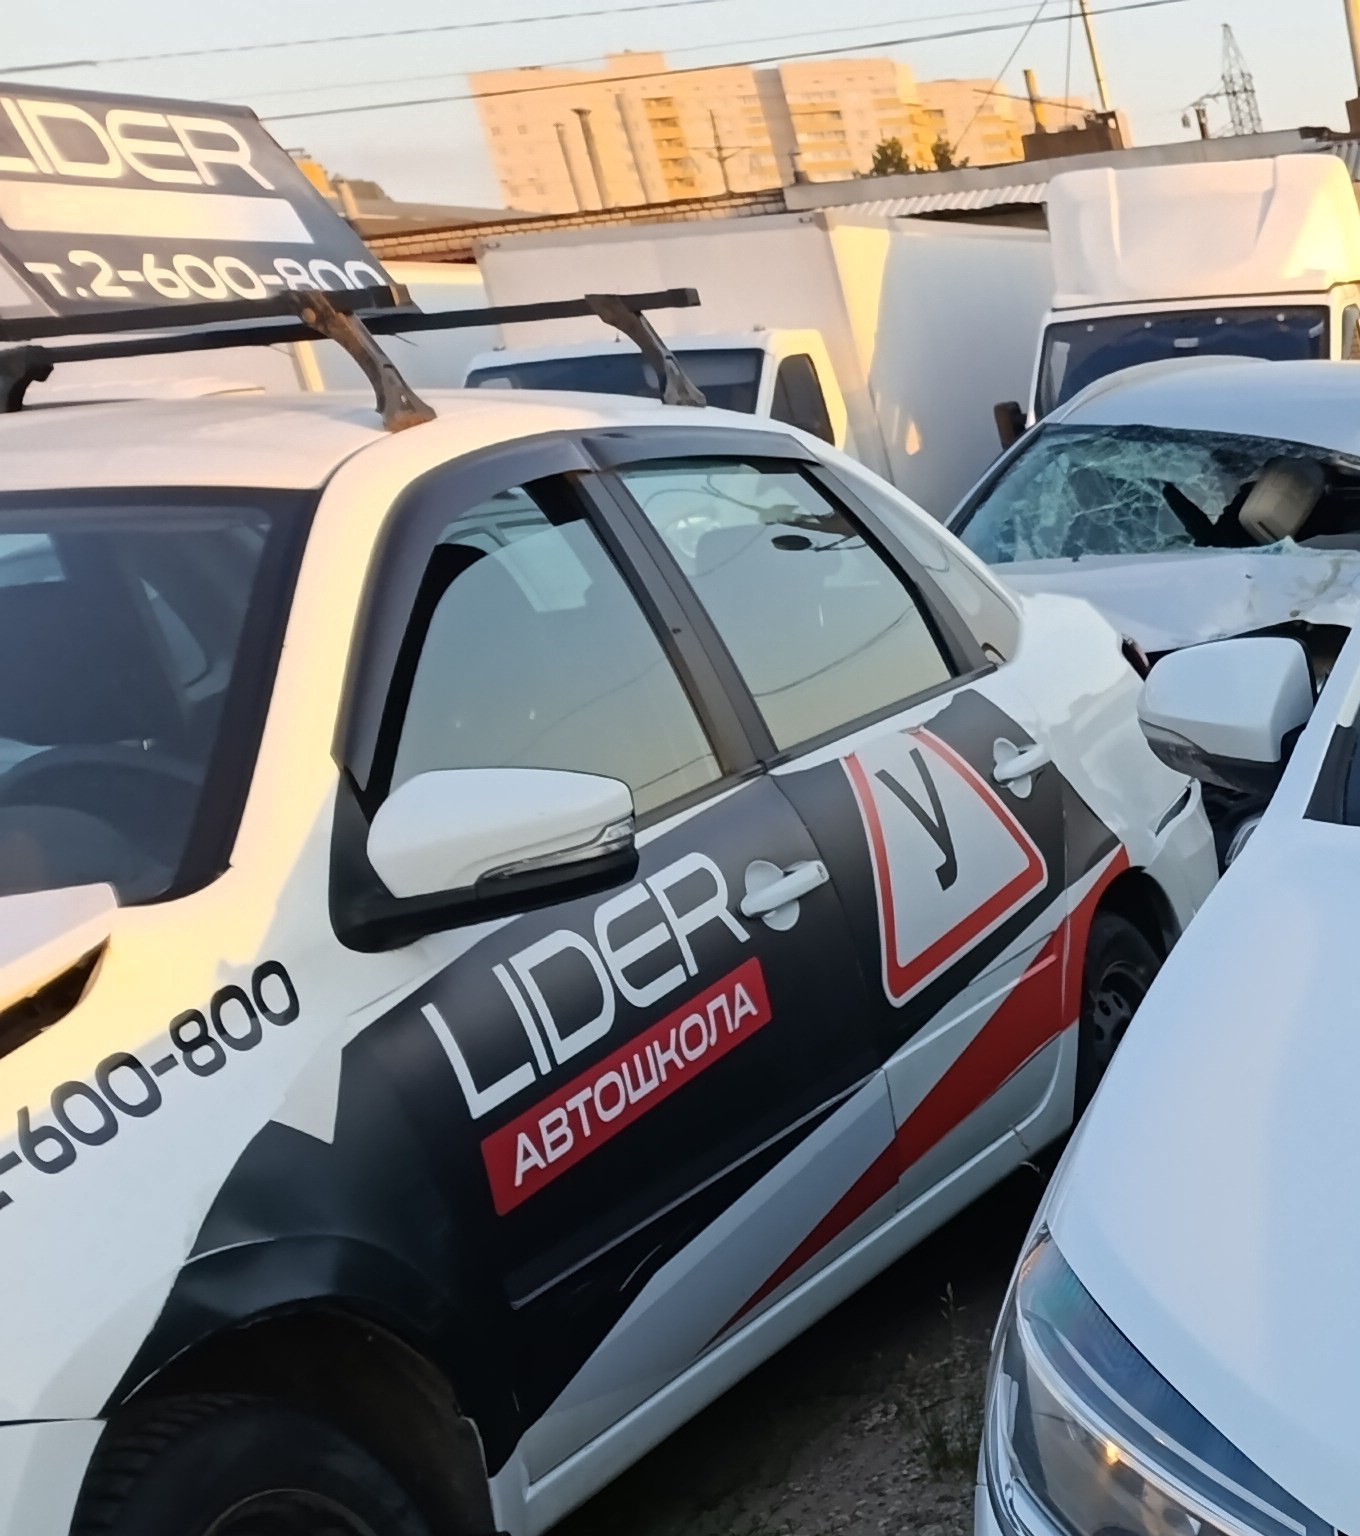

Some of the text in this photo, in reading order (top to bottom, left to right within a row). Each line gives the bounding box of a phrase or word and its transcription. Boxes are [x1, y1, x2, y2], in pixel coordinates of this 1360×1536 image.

[0, 97, 276, 190] IDER
[874, 747, 958, 892] У
[420, 852, 751, 1120] LIDER
[513, 982, 758, 1188] АВТОШКОЛА
